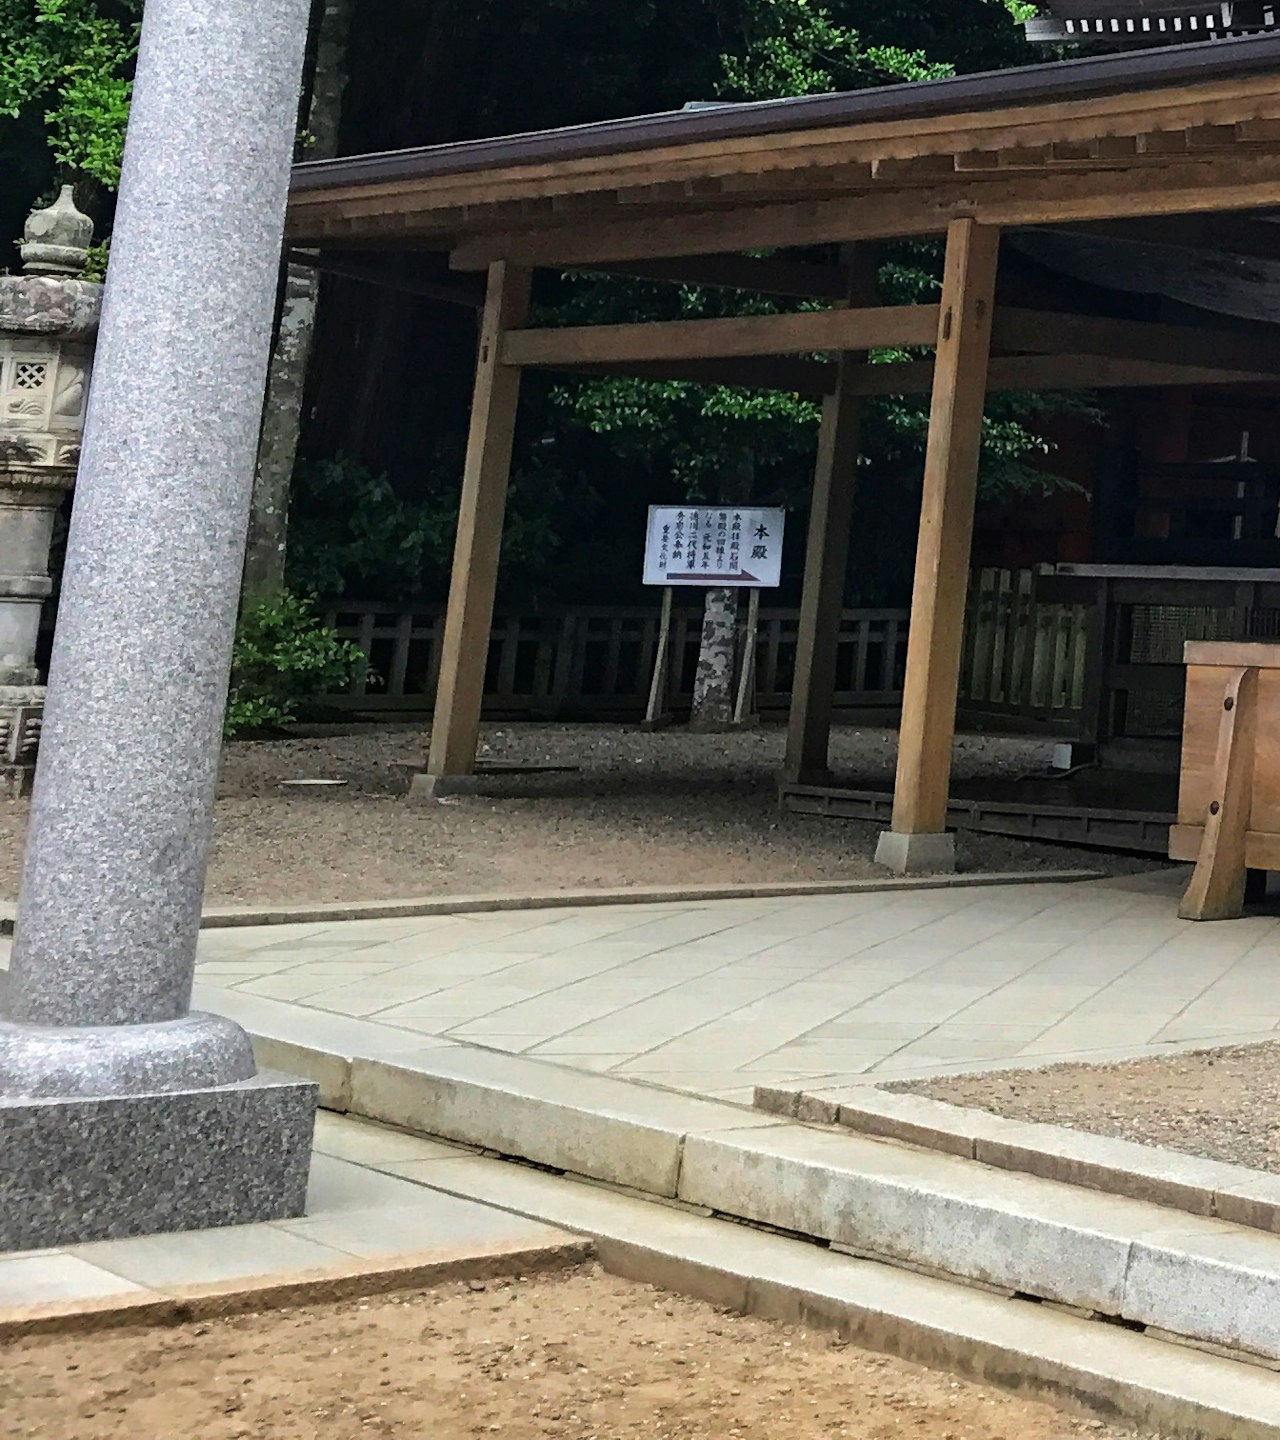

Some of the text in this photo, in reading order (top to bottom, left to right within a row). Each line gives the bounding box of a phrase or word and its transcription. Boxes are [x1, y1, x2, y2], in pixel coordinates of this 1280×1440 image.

[658, 524, 671, 570] 重要文化財
[750, 523, 770, 560] 本殿
